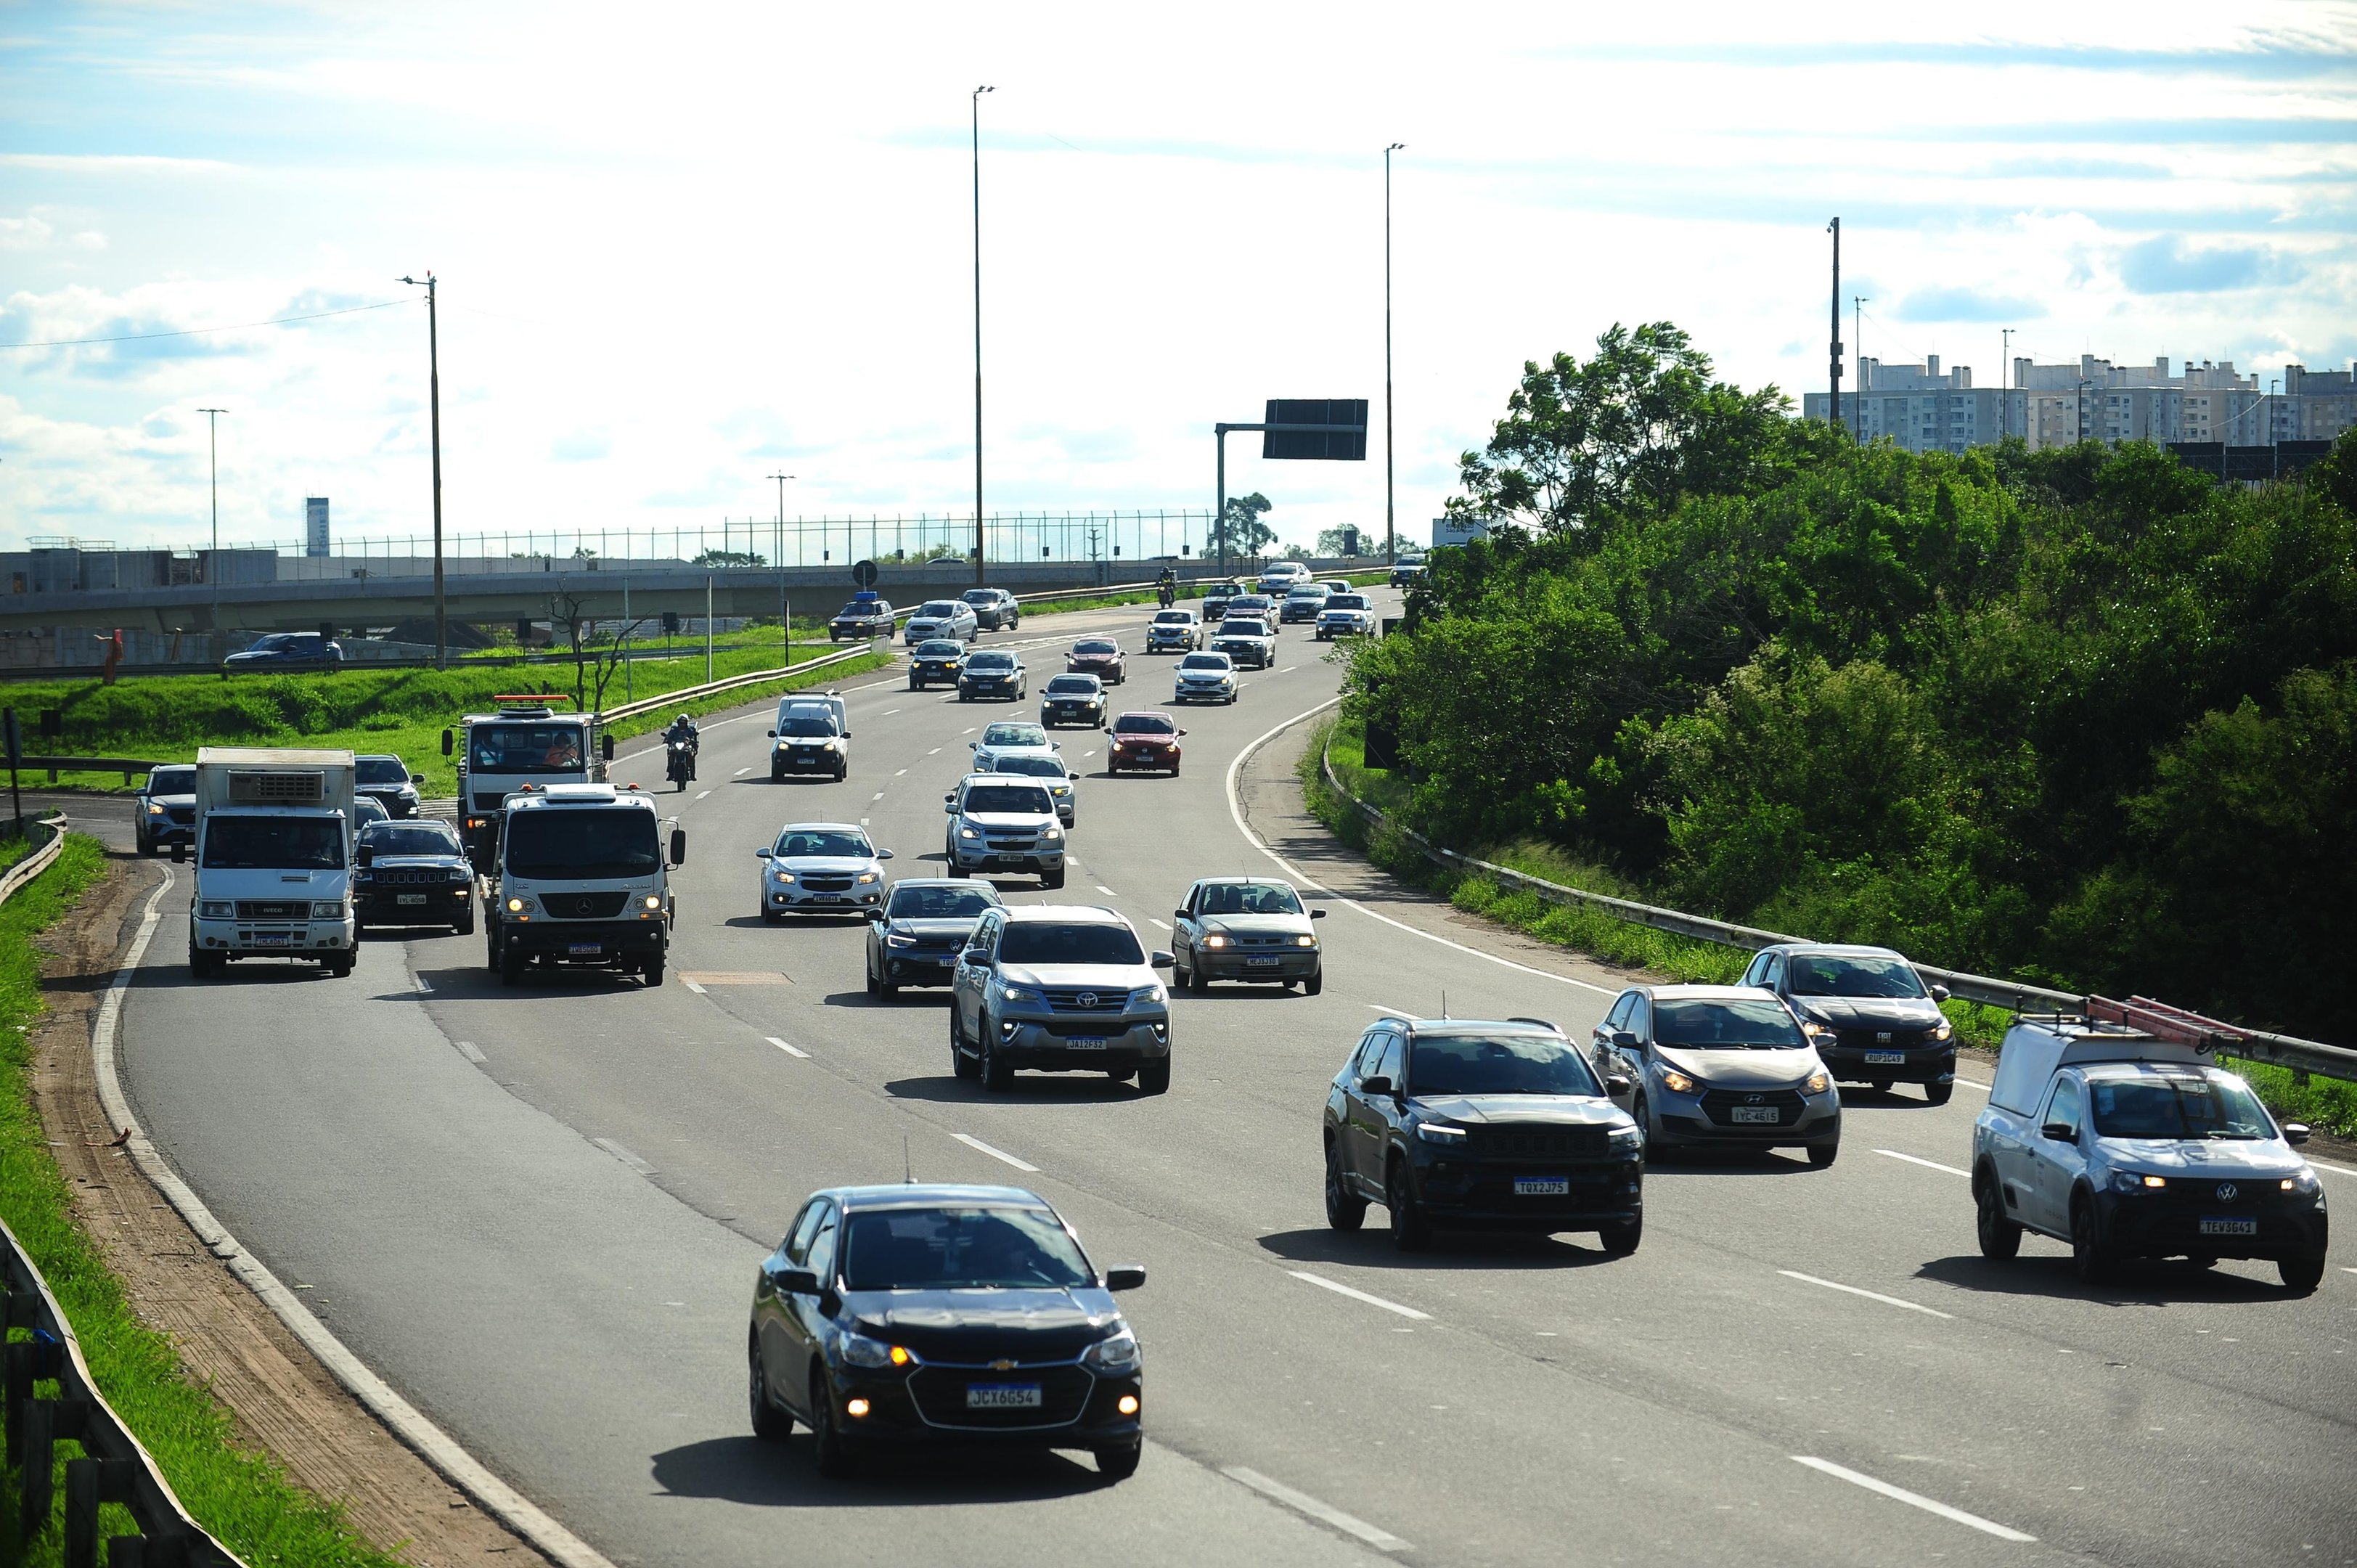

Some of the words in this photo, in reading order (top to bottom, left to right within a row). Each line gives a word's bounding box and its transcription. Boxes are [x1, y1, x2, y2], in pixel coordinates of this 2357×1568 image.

[1868, 1054, 1901, 1063] RUP1C49
[1520, 1183, 1564, 1193] TQX2J75
[2205, 1222, 2251, 1233] TEW3G41
[973, 1391, 1033, 1405] JCX6G54
